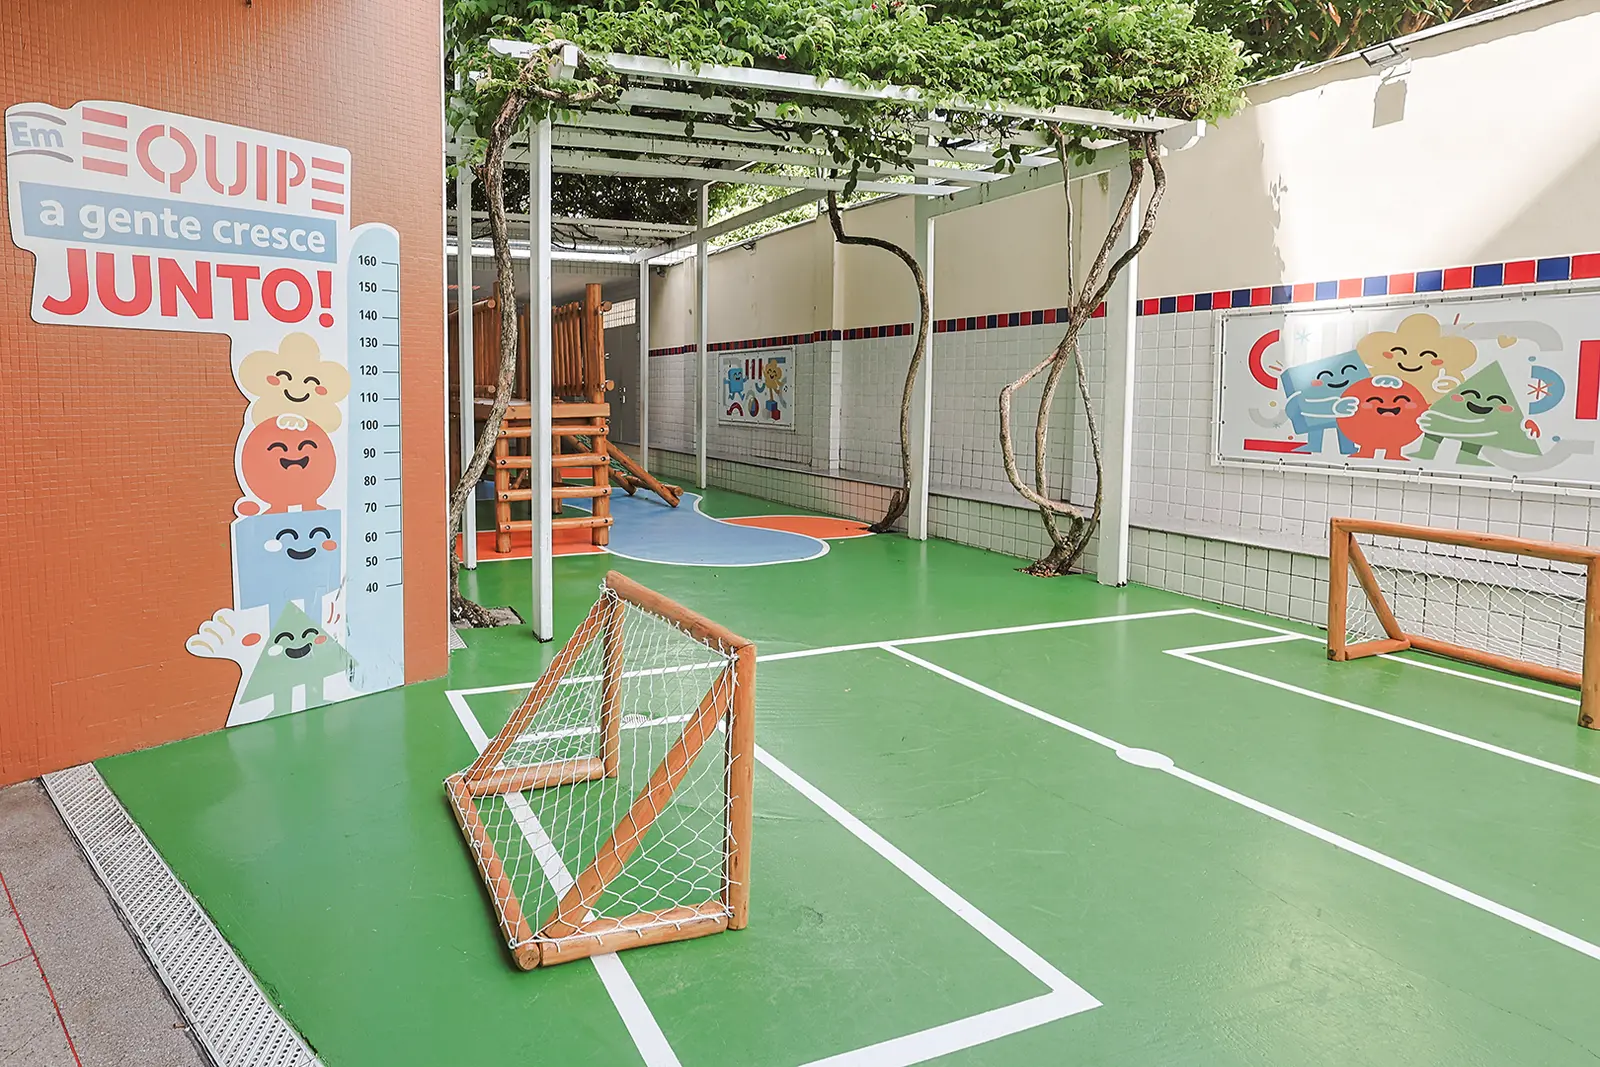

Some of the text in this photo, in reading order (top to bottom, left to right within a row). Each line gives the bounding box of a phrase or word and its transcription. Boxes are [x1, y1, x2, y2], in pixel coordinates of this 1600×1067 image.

[9, 107, 345, 215] Em EQUIPE
[39, 199, 326, 253] a gente cresce
[358, 255, 377, 267] 160
[42, 247, 335, 328] JUNTO!
[359, 282, 377, 293] 150
[359, 310, 378, 321] 140
[359, 337, 378, 348] 130
[359, 365, 378, 376] 120
[359, 392, 378, 403] 110
[360, 420, 379, 431] 100
[363, 448, 376, 459] 90
[364, 475, 377, 486] 80
[364, 502, 377, 513] 70
[365, 531, 378, 543] 60
[365, 556, 378, 567] 50
[365, 582, 378, 593] 40
